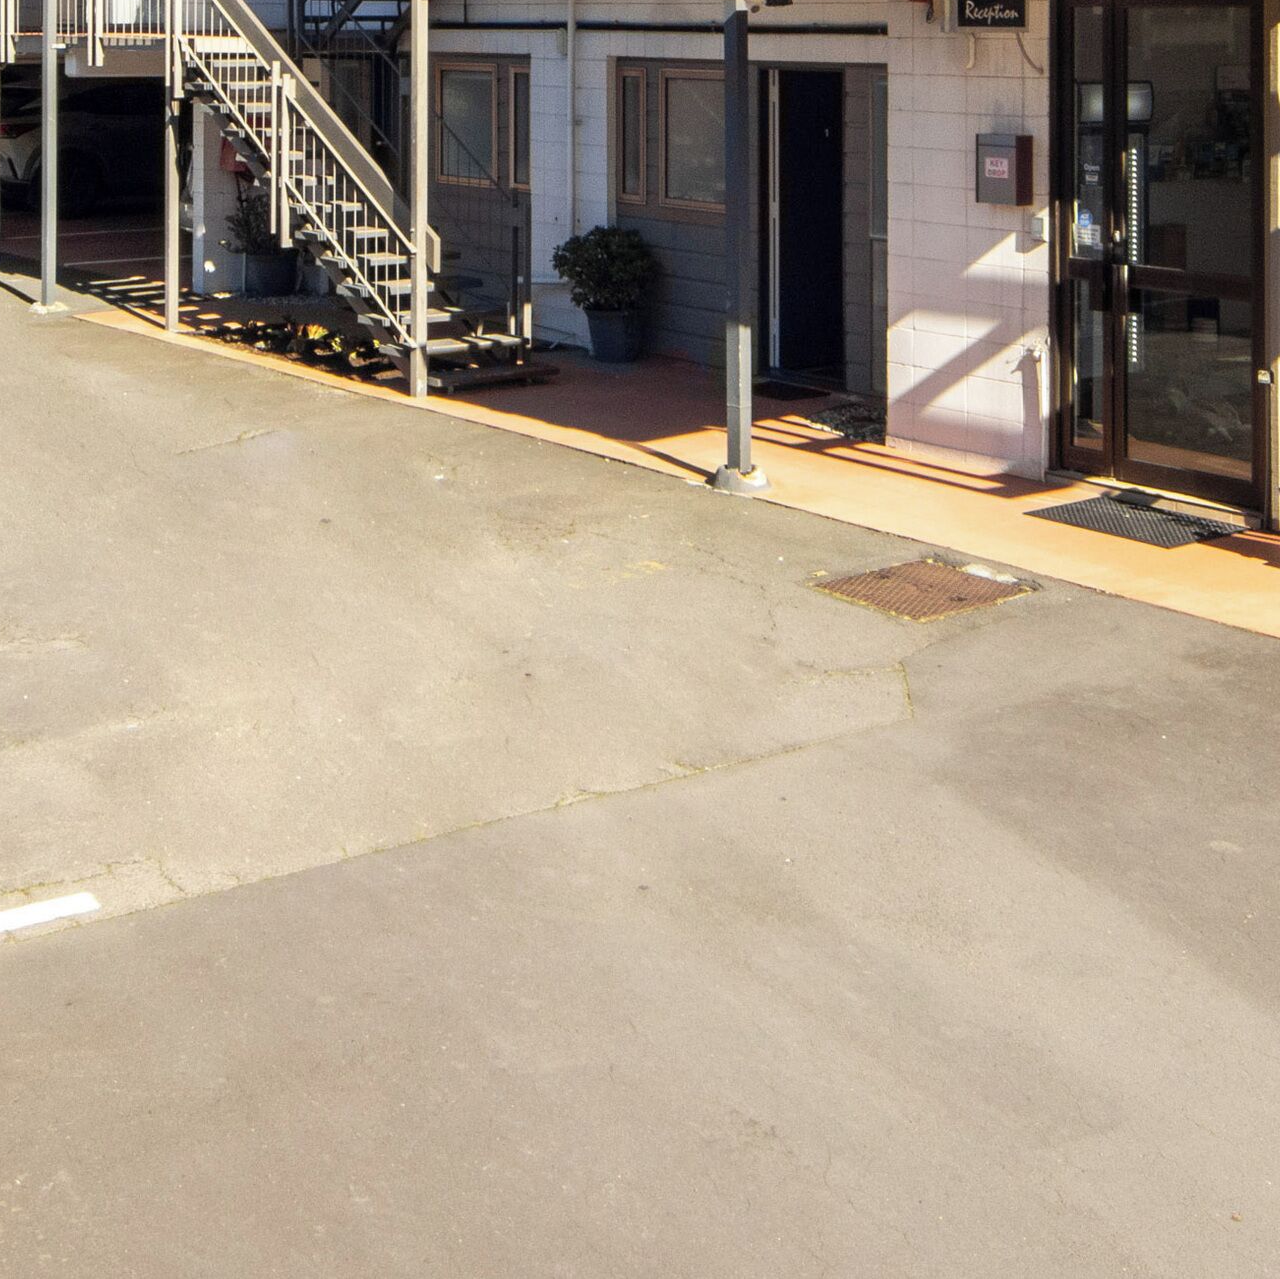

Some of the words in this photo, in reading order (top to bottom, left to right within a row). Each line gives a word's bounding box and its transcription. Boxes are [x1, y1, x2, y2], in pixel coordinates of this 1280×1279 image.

[965, 0, 1019, 24] Reception
[990, 160, 1003, 168] KEY
[1083, 163, 1100, 172] Open
[988, 169, 1006, 177] DROP
